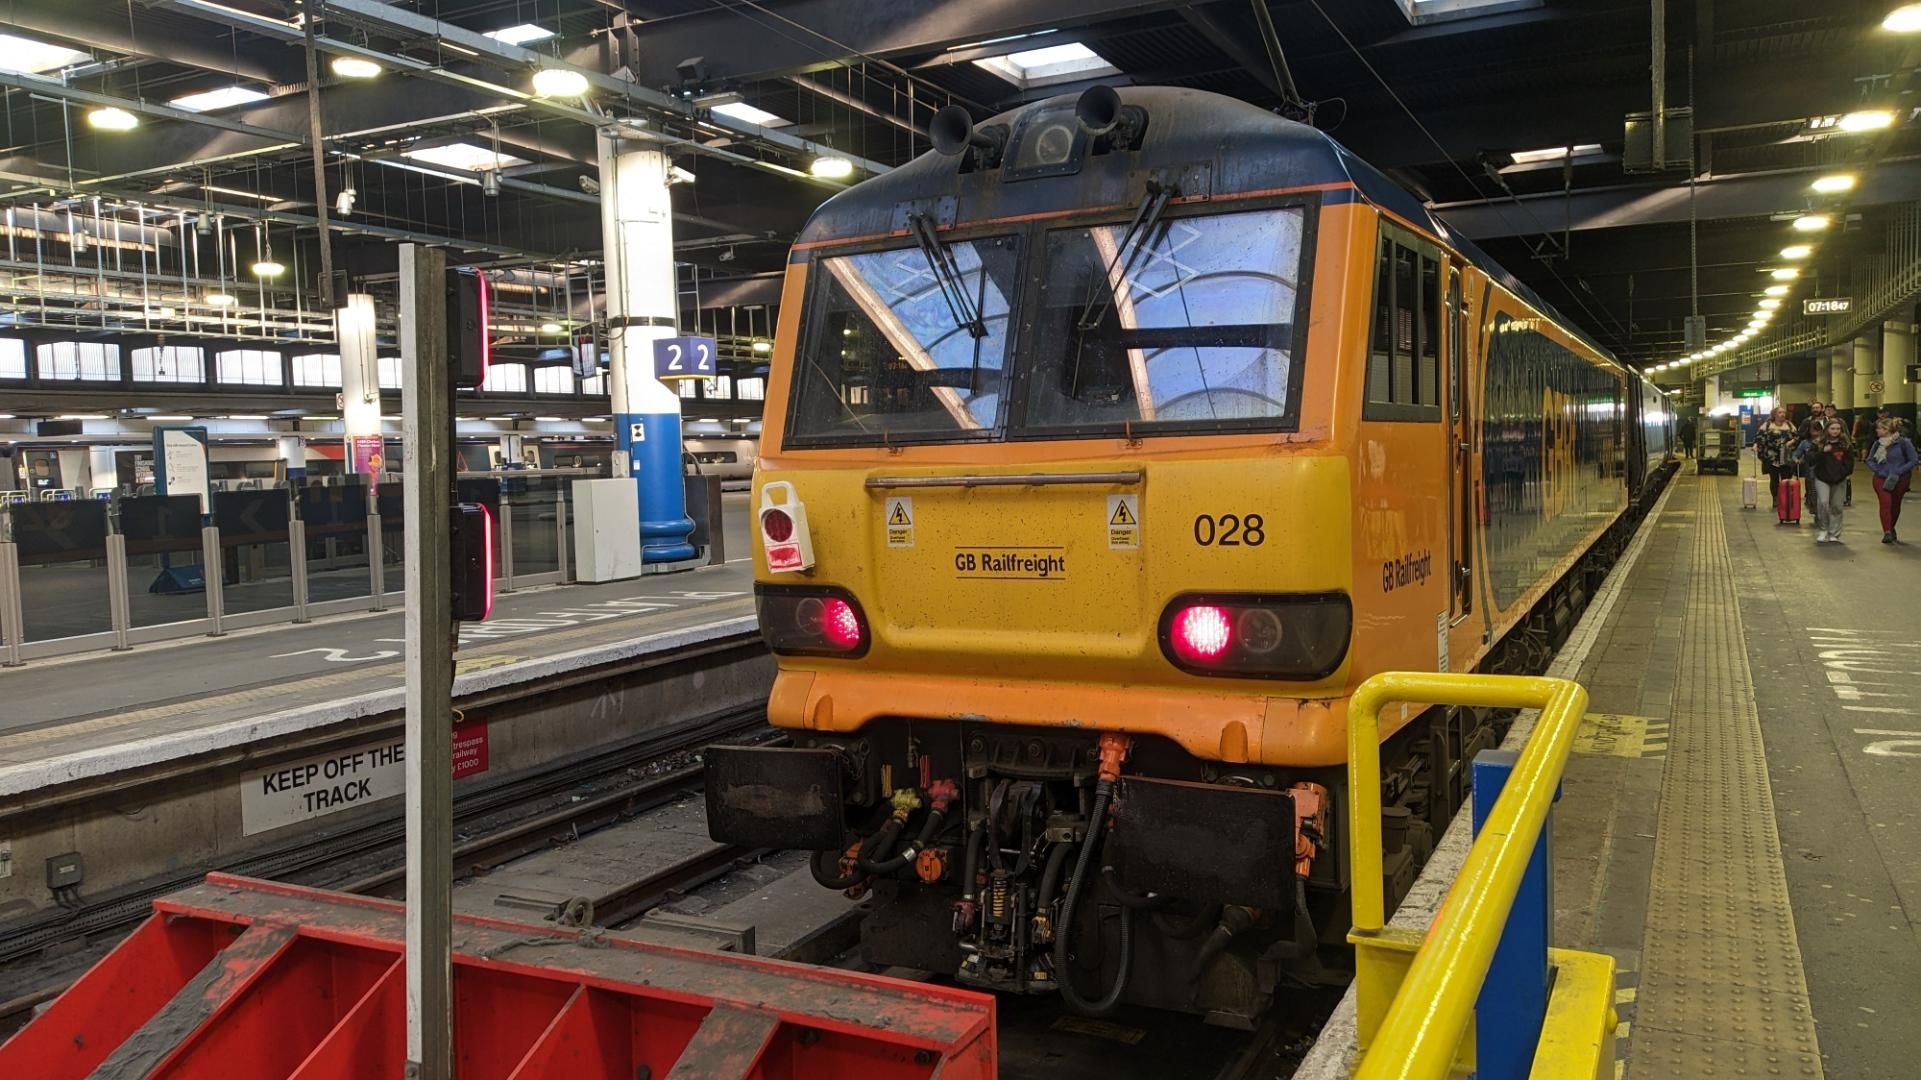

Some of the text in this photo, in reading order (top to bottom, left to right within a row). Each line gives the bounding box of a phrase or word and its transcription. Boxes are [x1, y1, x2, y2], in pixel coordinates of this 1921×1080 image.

[667, 344, 683, 370] 2
[697, 344, 710, 370] 2
[1194, 513, 1265, 546] 028
[955, 553, 1065, 577] GB Railfreight
[1383, 549, 1431, 593] GB Railfreight
[263, 743, 405, 795] KEEP OFF THE
[457, 758, 479, 770] £1000
[304, 778, 372, 813] TRACK
